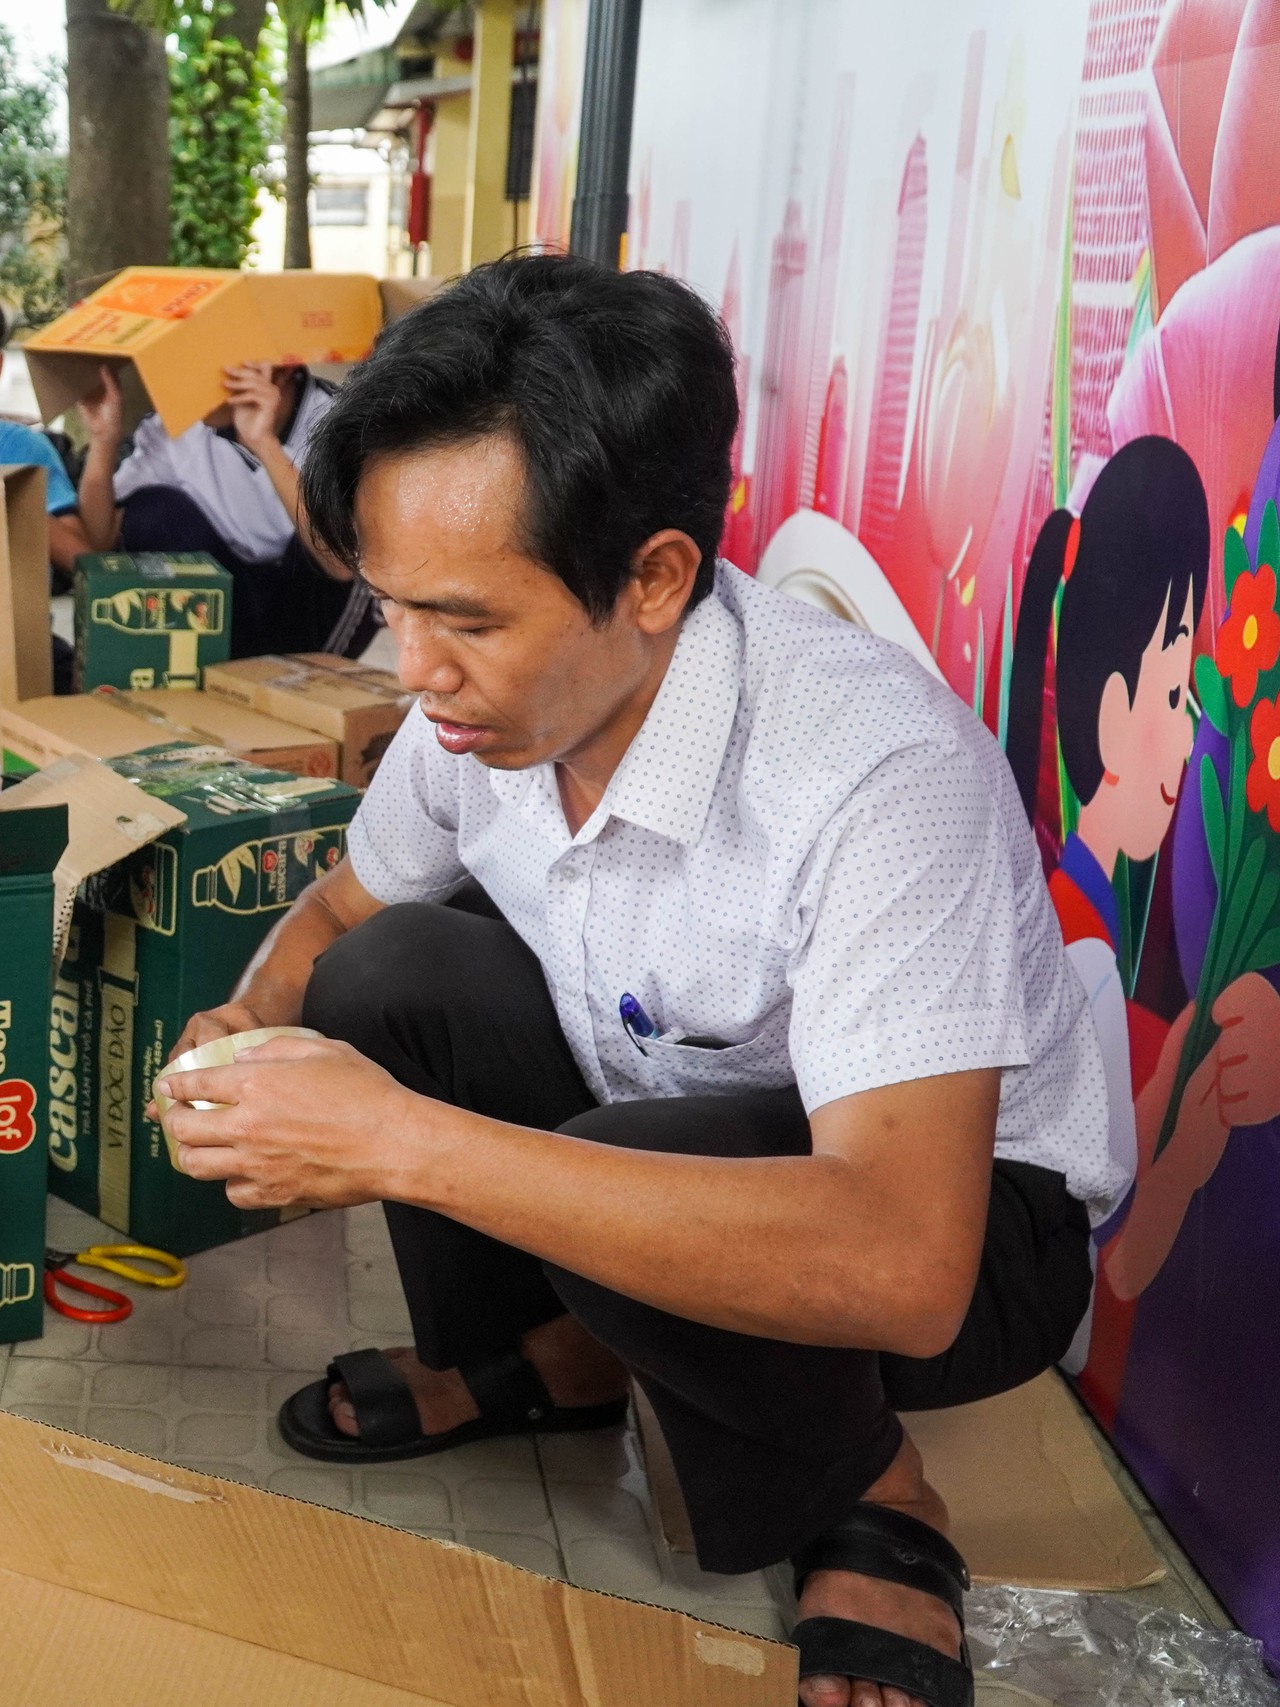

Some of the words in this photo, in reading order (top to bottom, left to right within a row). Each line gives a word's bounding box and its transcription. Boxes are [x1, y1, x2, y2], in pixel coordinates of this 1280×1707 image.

[276, 840, 287, 902] cascara
[104, 1004, 126, 1060] ĐÁO
[104, 1063, 127, 1122] ĐỘC
[107, 1127, 126, 1149] VỊ
